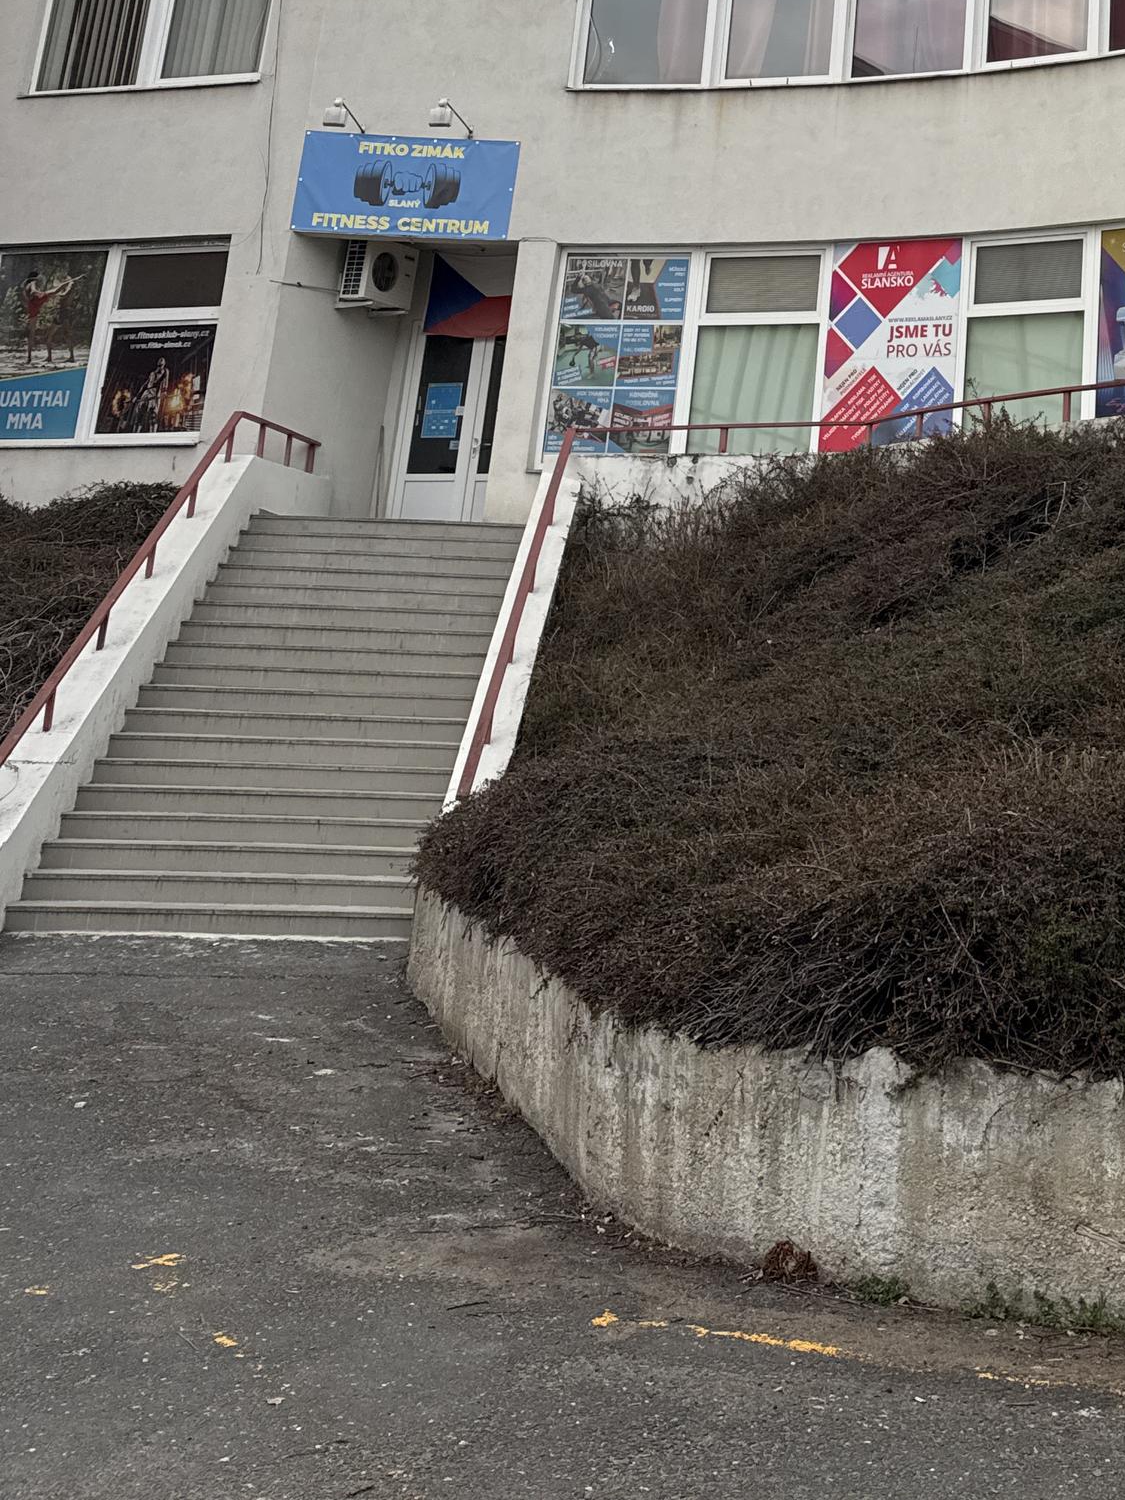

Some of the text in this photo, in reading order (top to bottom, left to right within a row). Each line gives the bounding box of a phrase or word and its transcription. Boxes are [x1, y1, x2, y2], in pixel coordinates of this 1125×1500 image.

[358, 141, 465, 159] FITKO ZIMÁK
[388, 198, 421, 209] SLANÝ
[311, 212, 489, 235] FITNESS CENTRUM
[576, 259, 623, 268] POSILOVNA
[626, 305, 655, 313] KARDIO
[887, 323, 953, 343] JSME TU
[886, 338, 952, 358] PRO VÁS
[0, 390, 70, 407] UAYTHAI
[6, 412, 43, 430] MMA
